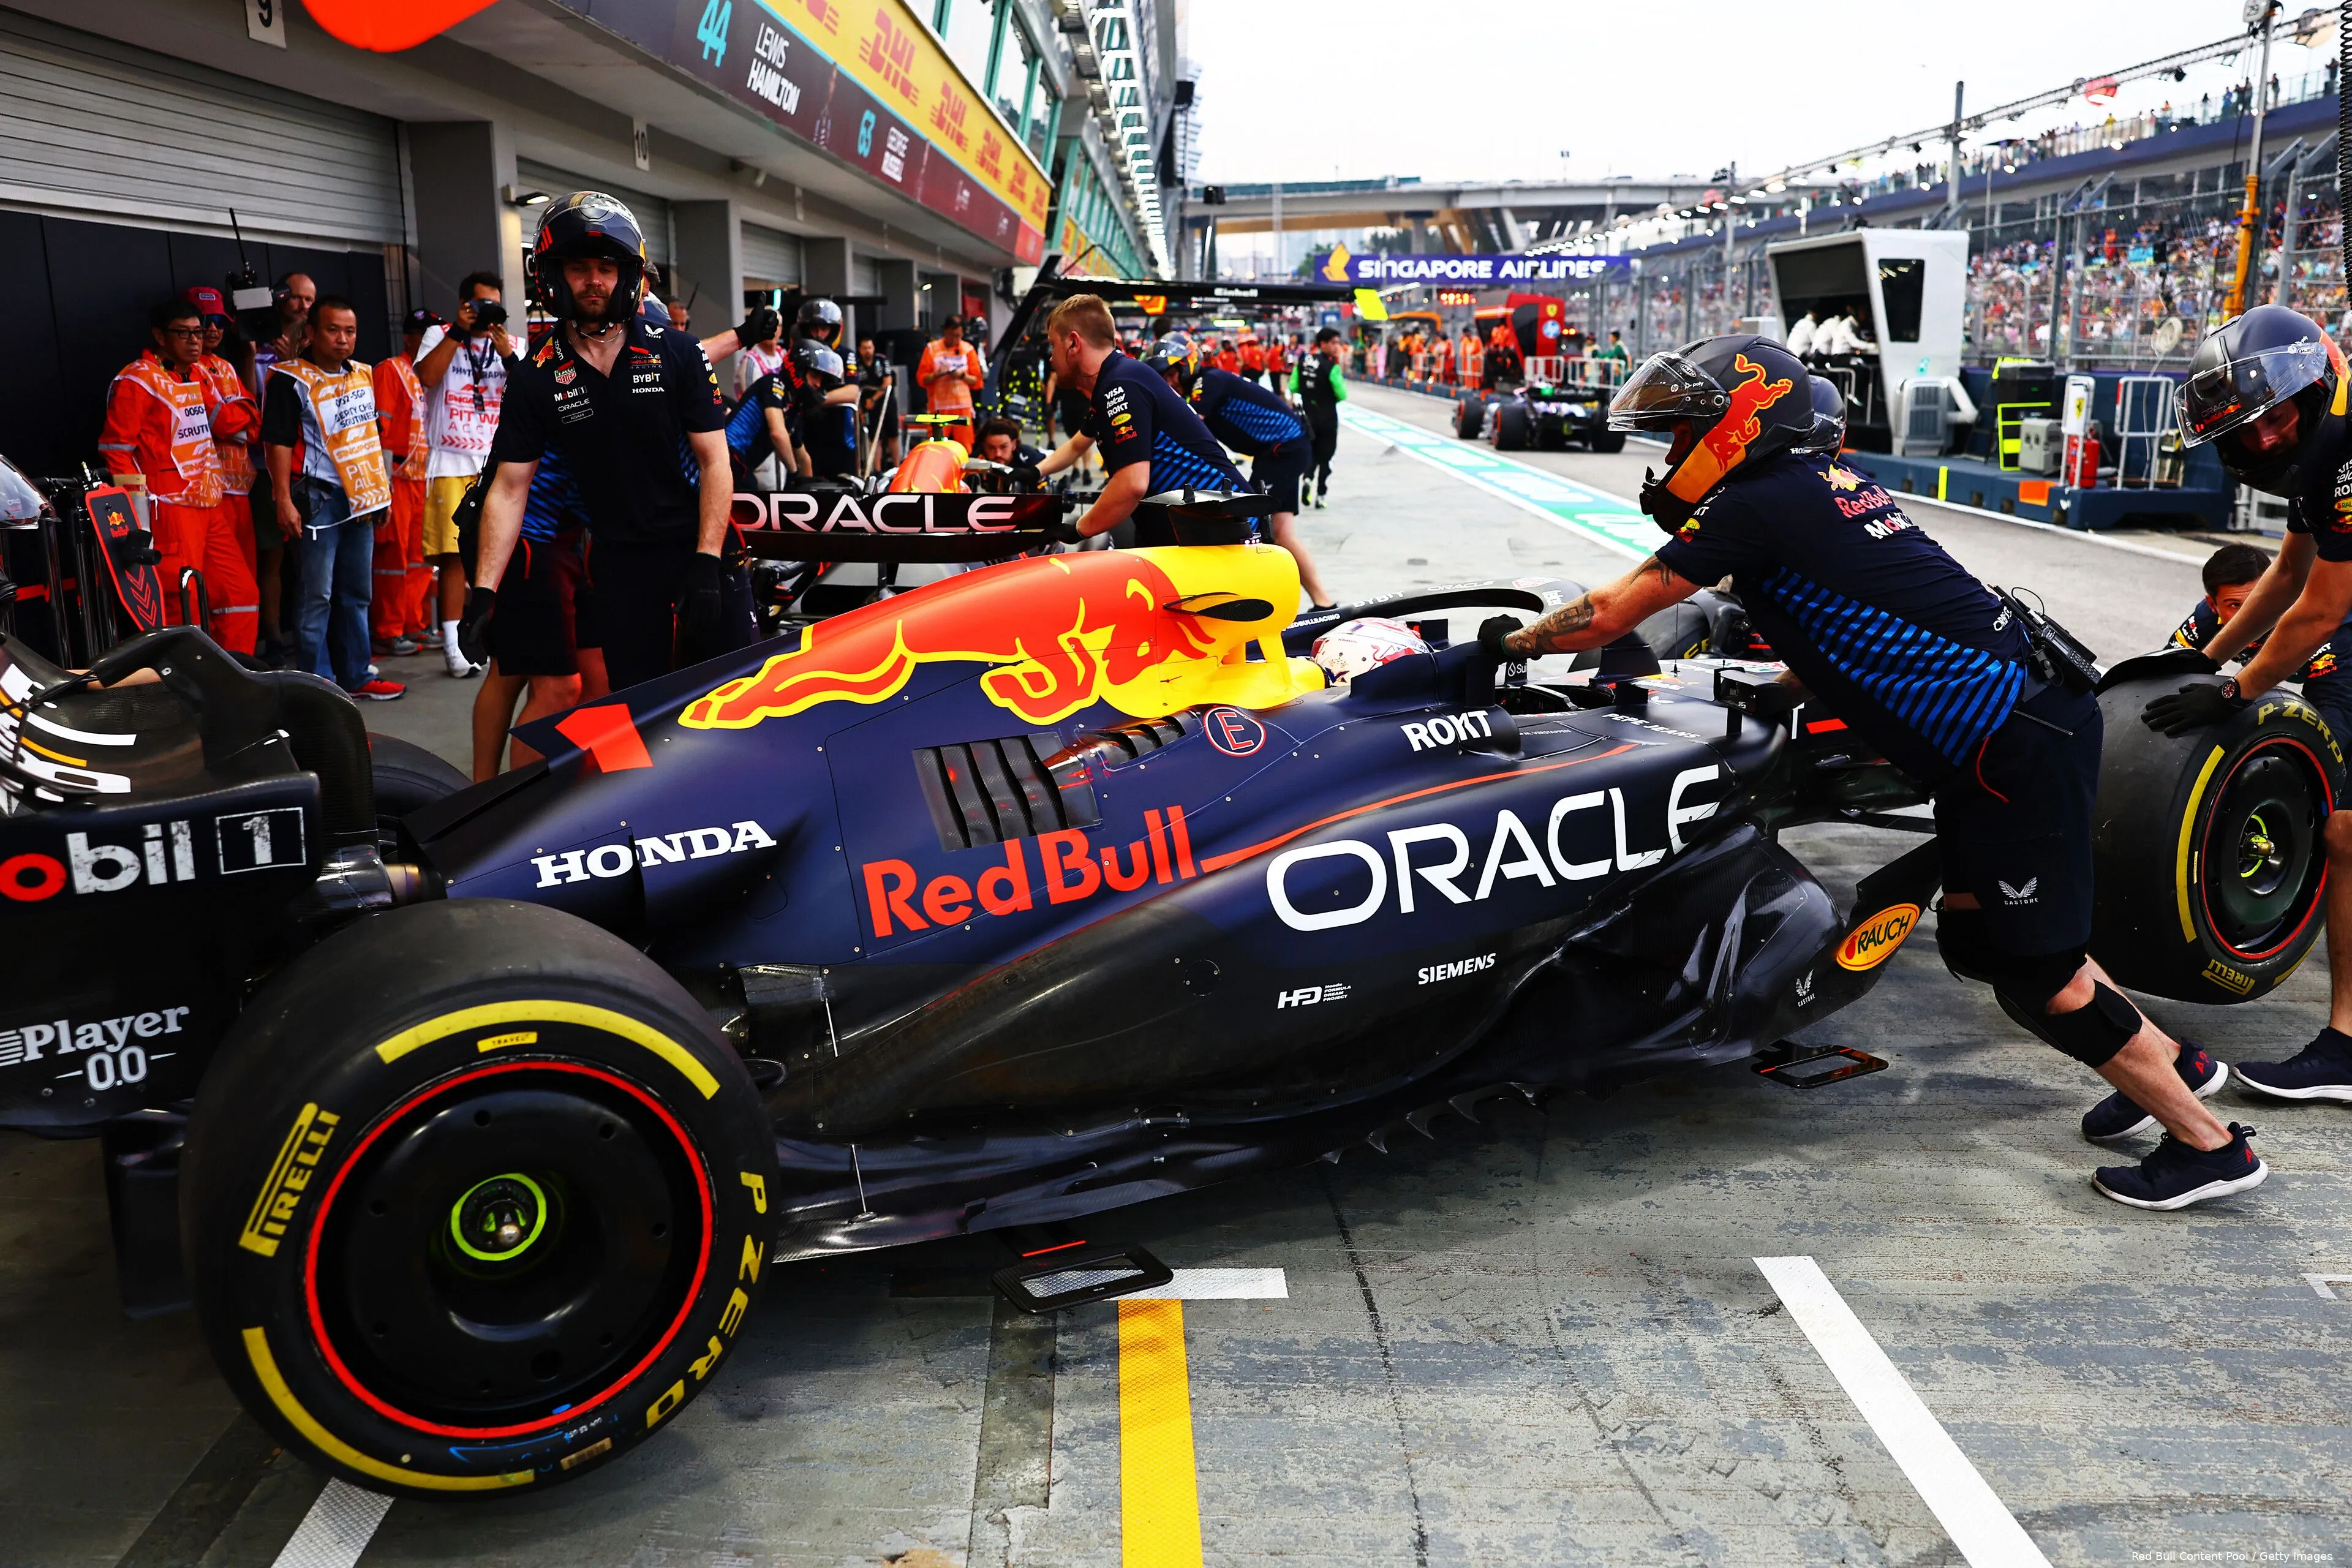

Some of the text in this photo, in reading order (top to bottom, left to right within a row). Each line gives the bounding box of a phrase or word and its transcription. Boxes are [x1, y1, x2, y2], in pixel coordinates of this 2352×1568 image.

[697, 0, 732, 67] 44
[755, 22, 790, 69] LEWIS
[859, 9, 919, 107] DHL
[746, 58, 801, 116] HAMILTON
[930, 80, 969, 153] DHL
[635, 130, 647, 160] 10
[554, 339, 564, 361] zoom
[557, 367, 574, 377] TAG
[557, 371, 576, 382] HEUER
[633, 372, 660, 383] BYBIT
[554, 388, 579, 402] Mobil
[558, 398, 590, 412] ORACLE
[1104, 386, 1124, 399] VISA
[1107, 402, 1128, 417] ROKT
[2202, 395, 2238, 417] ORACLE
[450, 408, 474, 421] PIT
[734, 493, 1017, 532] ORACLE
[1834, 492, 1871, 518] Red
[1352, 590, 1405, 608] BYBIT
[1427, 580, 1495, 591] ORACLE
[1219, 712, 1252, 750] E
[1401, 710, 1493, 752] ROKT
[1602, 713, 1701, 739] PEPE JEANS
[0, 820, 195, 902] obil
[530, 820, 777, 888] HONDA
[1266, 764, 1719, 932] ORACLE
[862, 805, 1197, 938] Red Bull
[1857, 913, 1912, 954] RAUCH
[1418, 952, 1496, 985] SIEMENS
[2202, 959, 2255, 995] PIRELLI
[1798, 993, 1815, 1008] CASTORE
[21, 1006, 189, 1061] Player
[85, 1046, 148, 1091] 0.0
[239, 1102, 341, 1257] PIRELLI
[646, 1234, 764, 1428] ZERO
